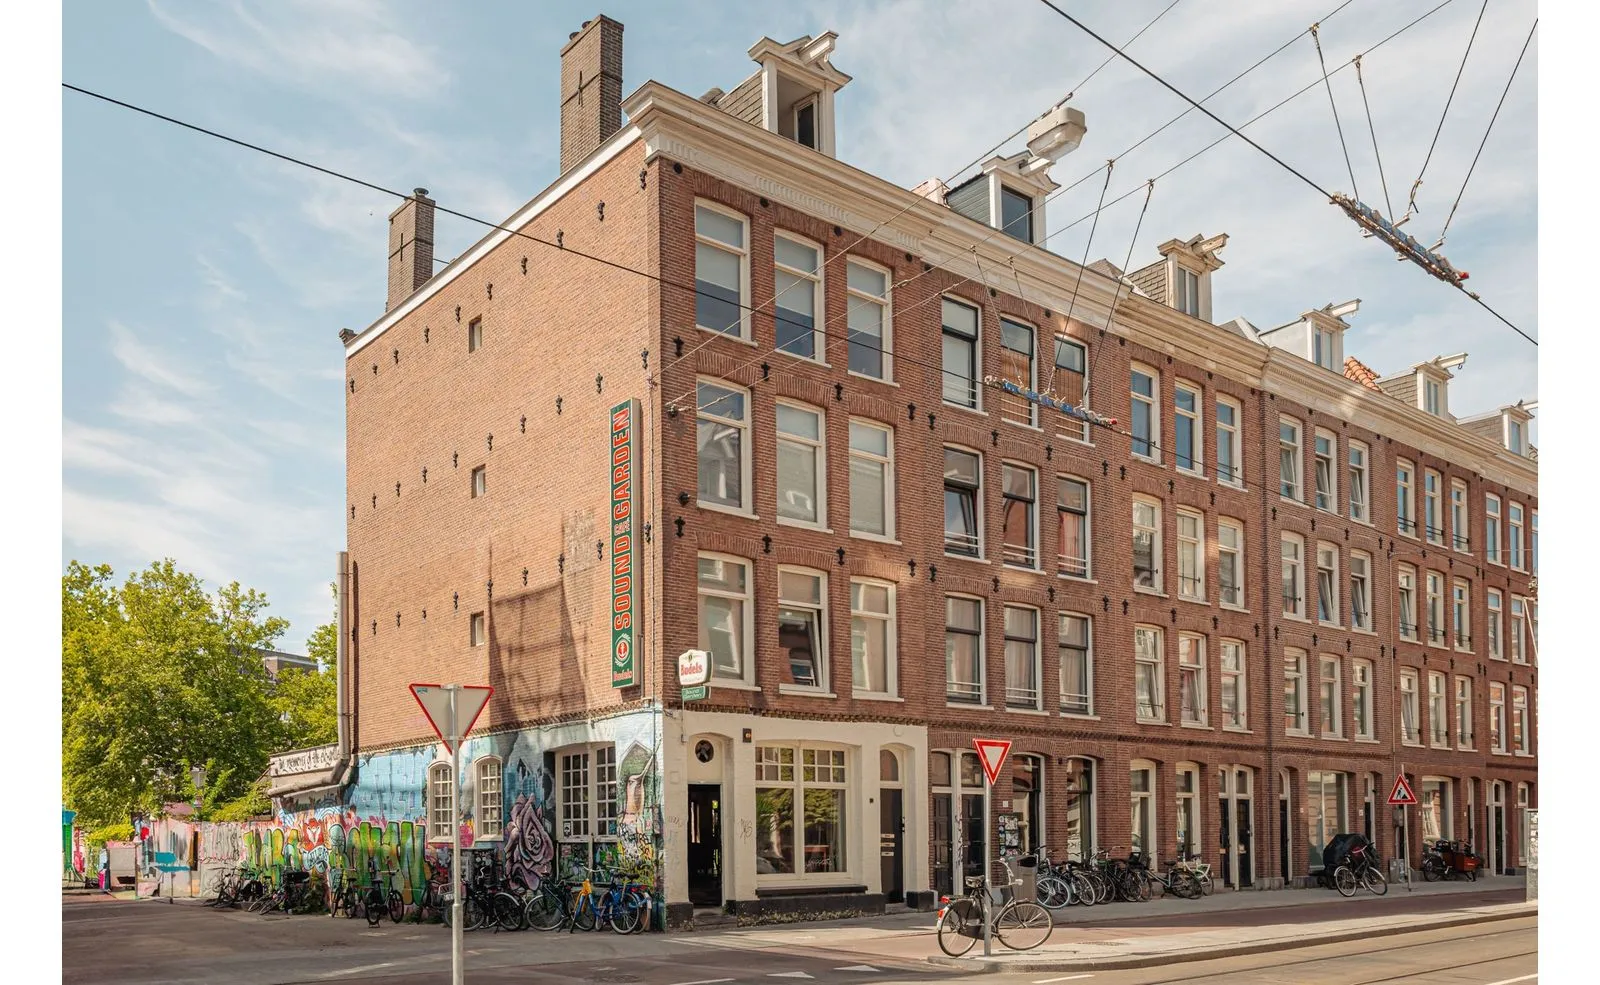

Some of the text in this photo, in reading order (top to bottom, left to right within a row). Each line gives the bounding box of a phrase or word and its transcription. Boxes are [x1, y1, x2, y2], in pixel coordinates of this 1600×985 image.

[612, 407, 632, 631] SOUND GARDEN
[681, 662, 703, 676] Budels
